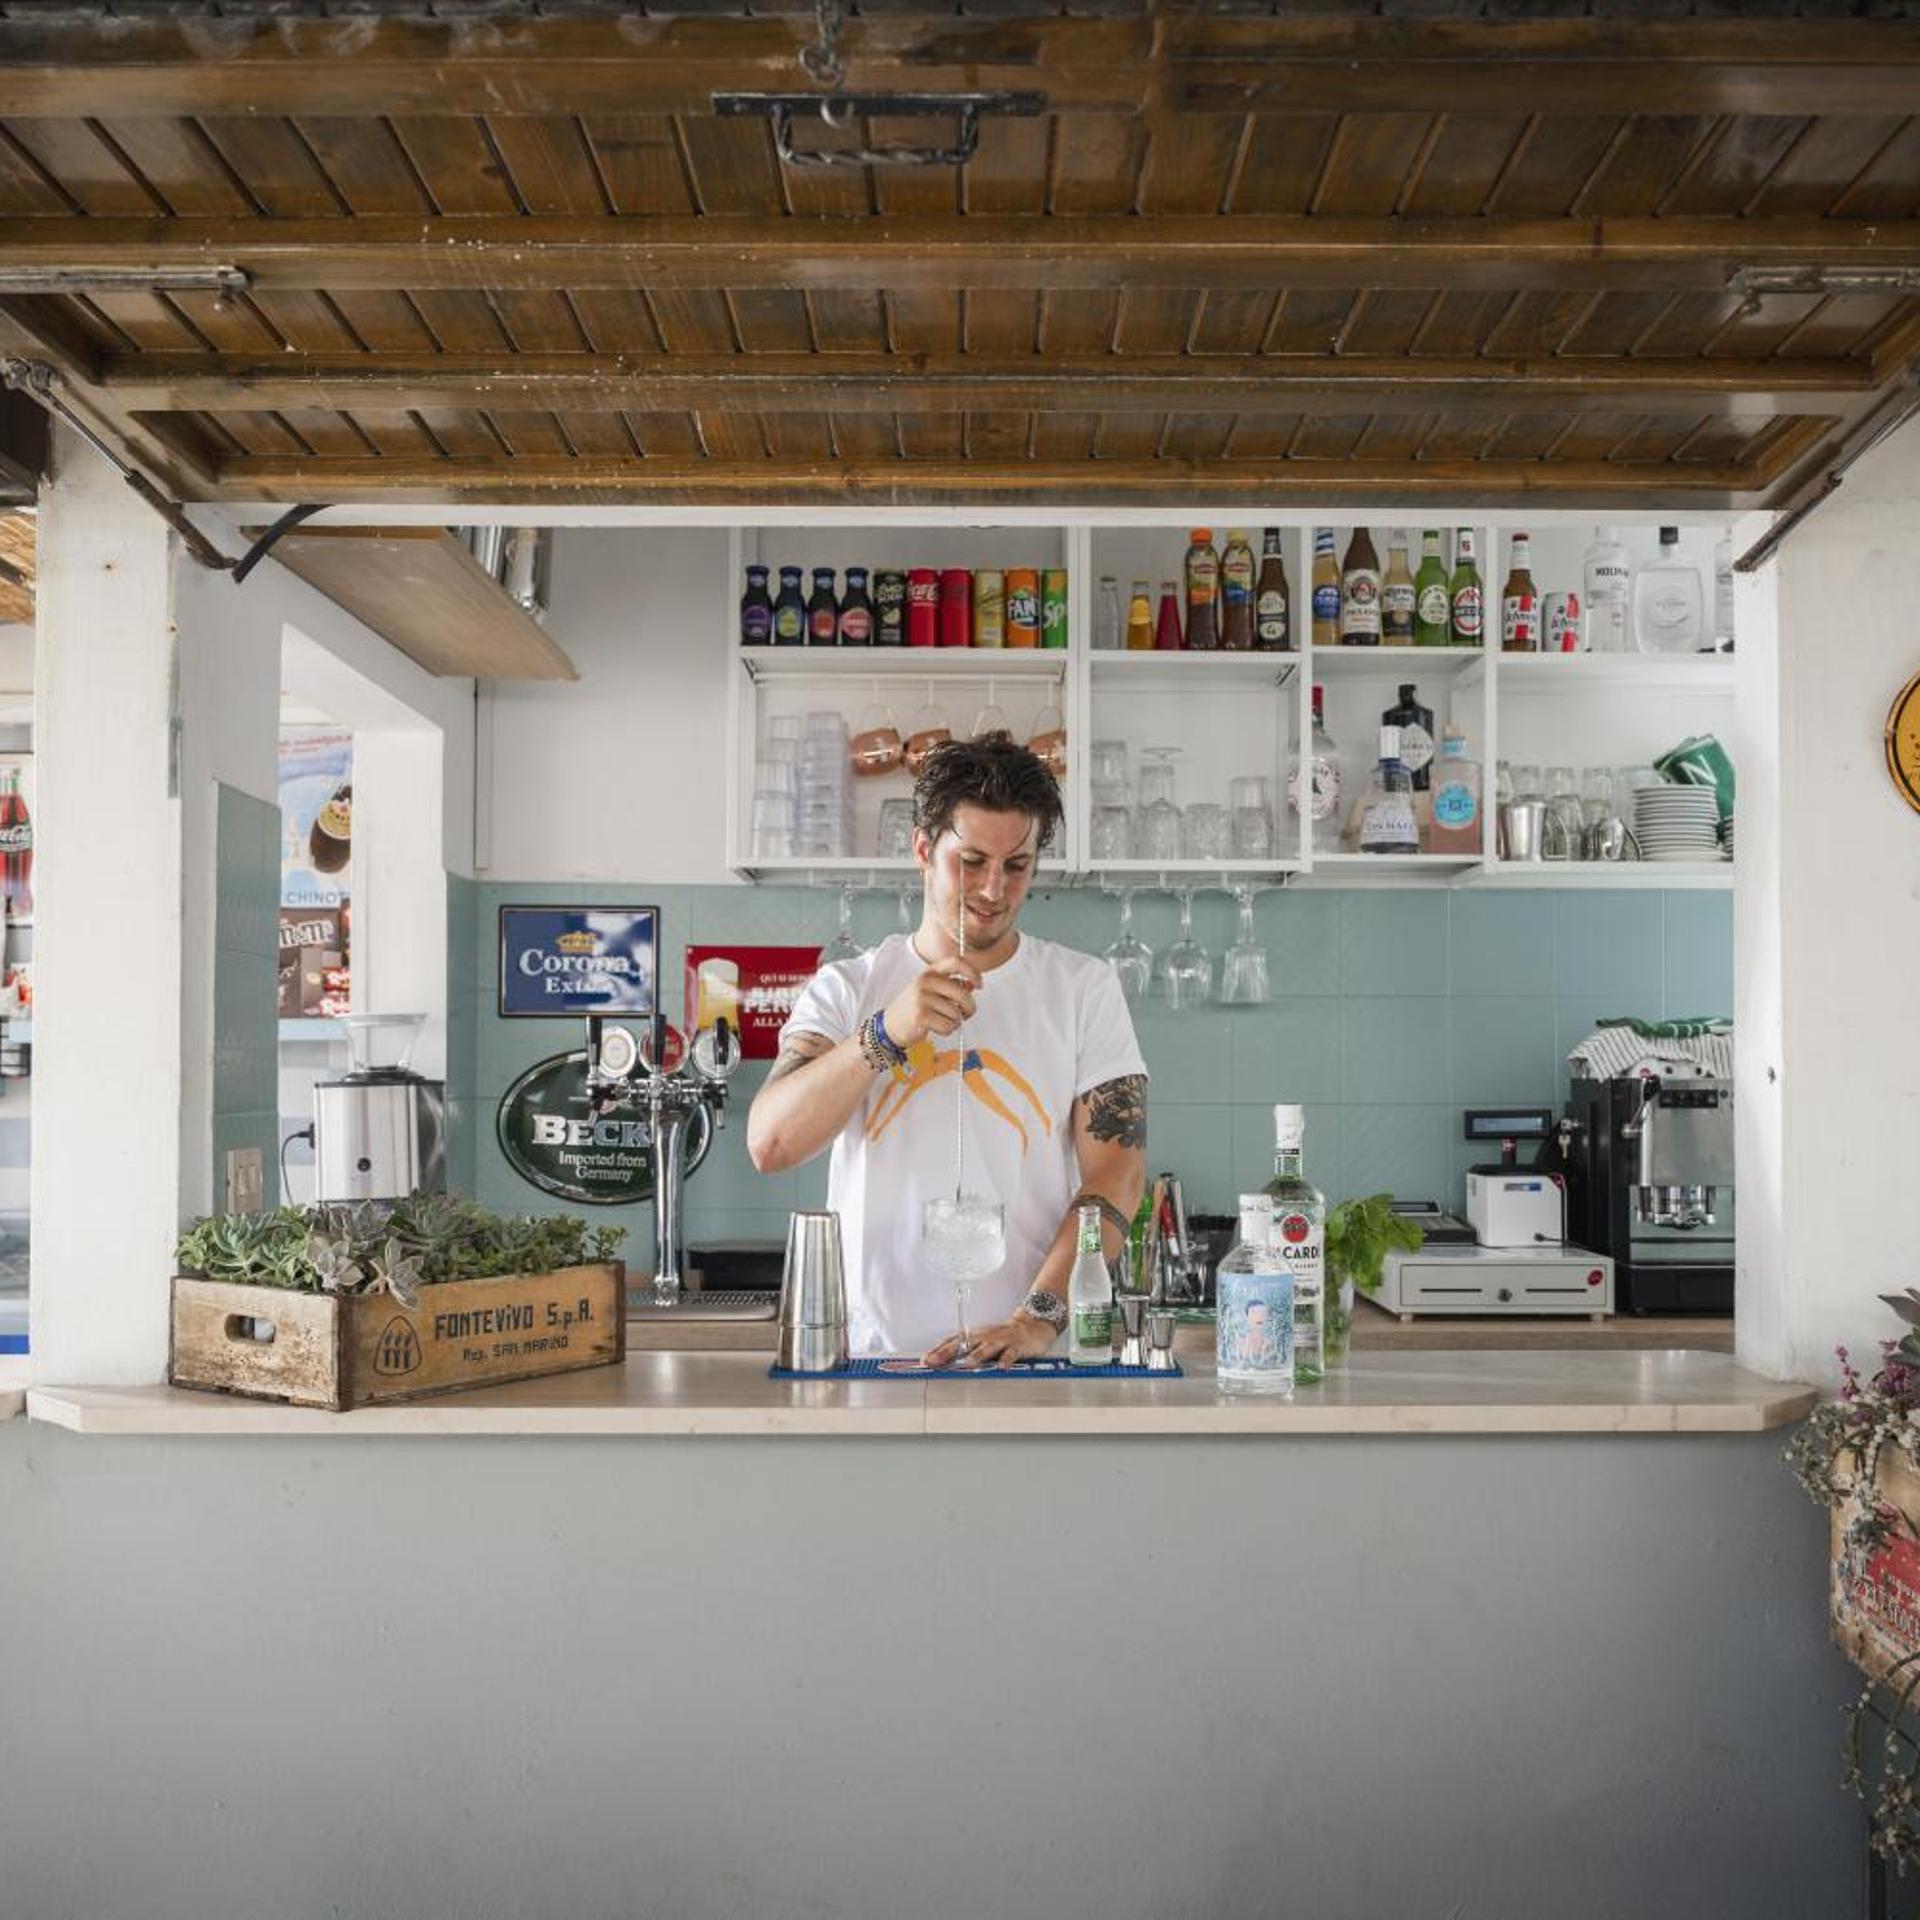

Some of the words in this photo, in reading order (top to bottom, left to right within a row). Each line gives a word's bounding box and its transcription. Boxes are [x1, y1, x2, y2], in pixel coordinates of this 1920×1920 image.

[519, 948, 630, 977] Corona
[743, 998, 793, 1013] PER
[531, 1114, 652, 1148] BECK
[559, 1150, 614, 1167] Imported
[617, 1152, 647, 1167] from
[576, 1165, 633, 1183] Germany
[493, 1341, 518, 1358] SAN
[523, 1335, 569, 1355] MARINO
